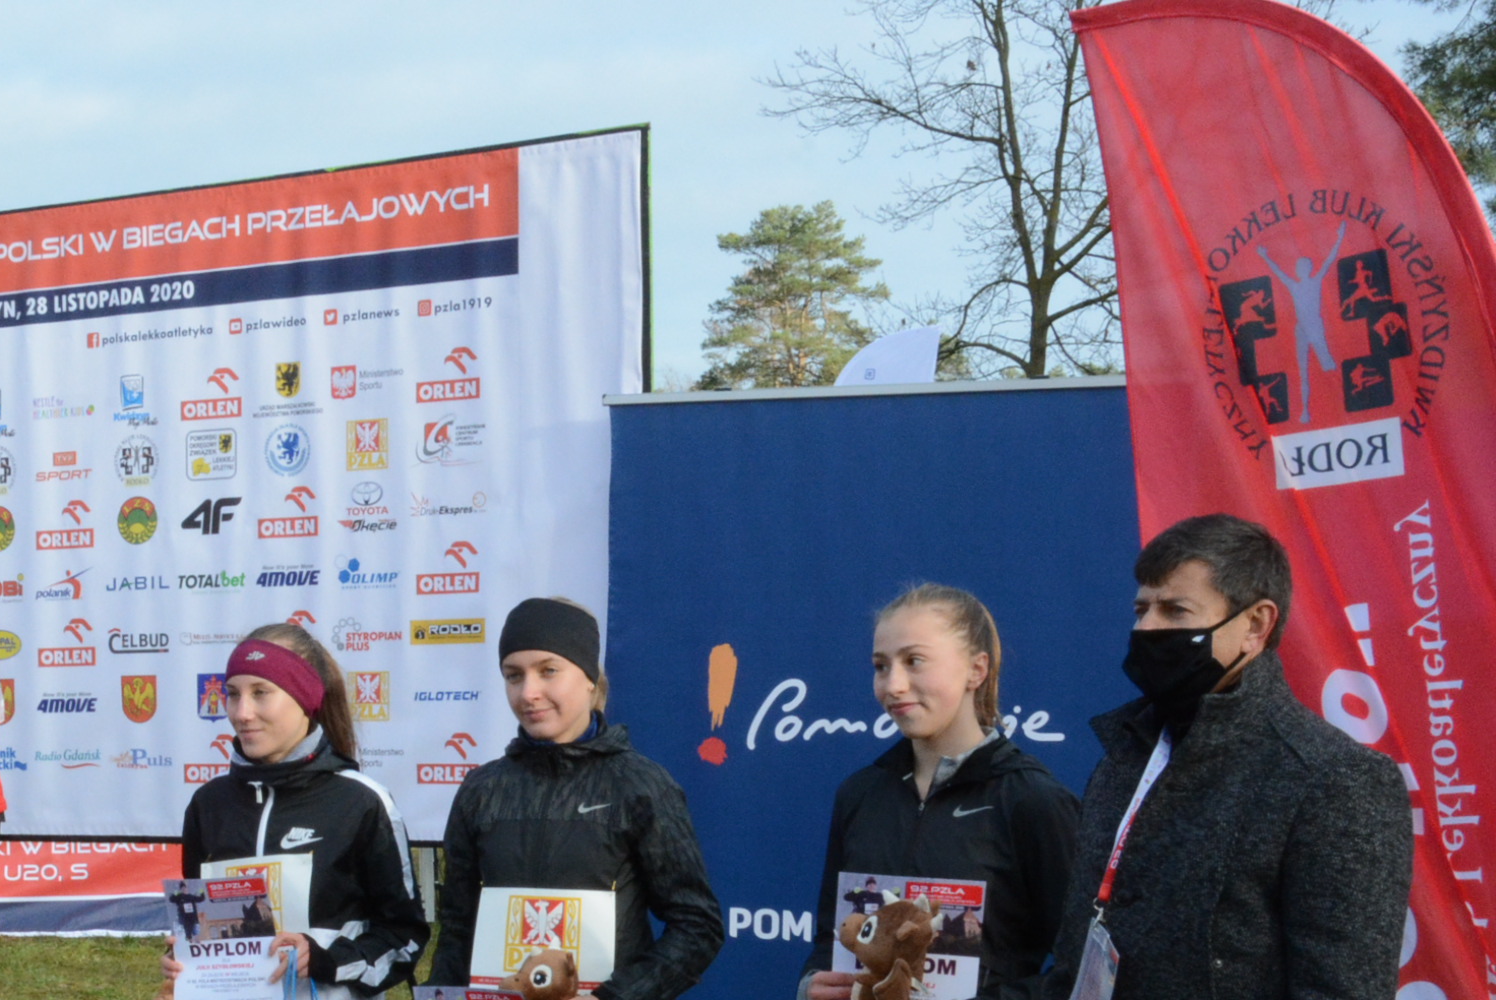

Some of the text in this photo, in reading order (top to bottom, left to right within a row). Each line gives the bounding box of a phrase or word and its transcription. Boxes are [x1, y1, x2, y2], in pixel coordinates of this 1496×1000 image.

[90, 229, 118, 252] W
[123, 214, 241, 250] BIEGACH
[247, 183, 490, 235] PRZEŁAJOWYCH
[26, 297, 48, 316] 28
[54, 286, 145, 313] LISTOPADA
[151, 281, 195, 303] 2020
[434, 296, 493, 316] pzla1919
[342, 306, 400, 324] pzlanews
[245, 315, 307, 334] pzlawideo
[102, 325, 213, 346] polskalekkoatletyka
[418, 380, 478, 400] ORLEN
[184, 399, 239, 419] ORLEN
[347, 452, 387, 468] PZLA
[35, 468, 92, 483] SPORT
[181, 496, 243, 536] 4F
[346, 506, 389, 517] TOYOTA
[259, 519, 317, 536] ORLEN
[38, 531, 92, 548] ORLEN
[106, 575, 170, 592] JABIL
[178, 570, 246, 590] TOTALbet
[256, 570, 321, 588] 4MOVE
[351, 572, 399, 585] OLIMP
[419, 575, 477, 593] ORLEN
[35, 588, 72, 600] polanik
[345, 631, 403, 642] STYROPIAN
[345, 642, 370, 652] PLUS
[40, 650, 94, 666] ORLEN
[414, 690, 480, 702] IGLOTECH
[36, 697, 99, 714] 4MOVE
[34, 748, 102, 762] Radio Gdańsk
[130, 748, 173, 767] Puls
[289, 827, 315, 840] NIKE
[4, 863, 89, 882] U20, S
[189, 940, 262, 958] DYPLOM
